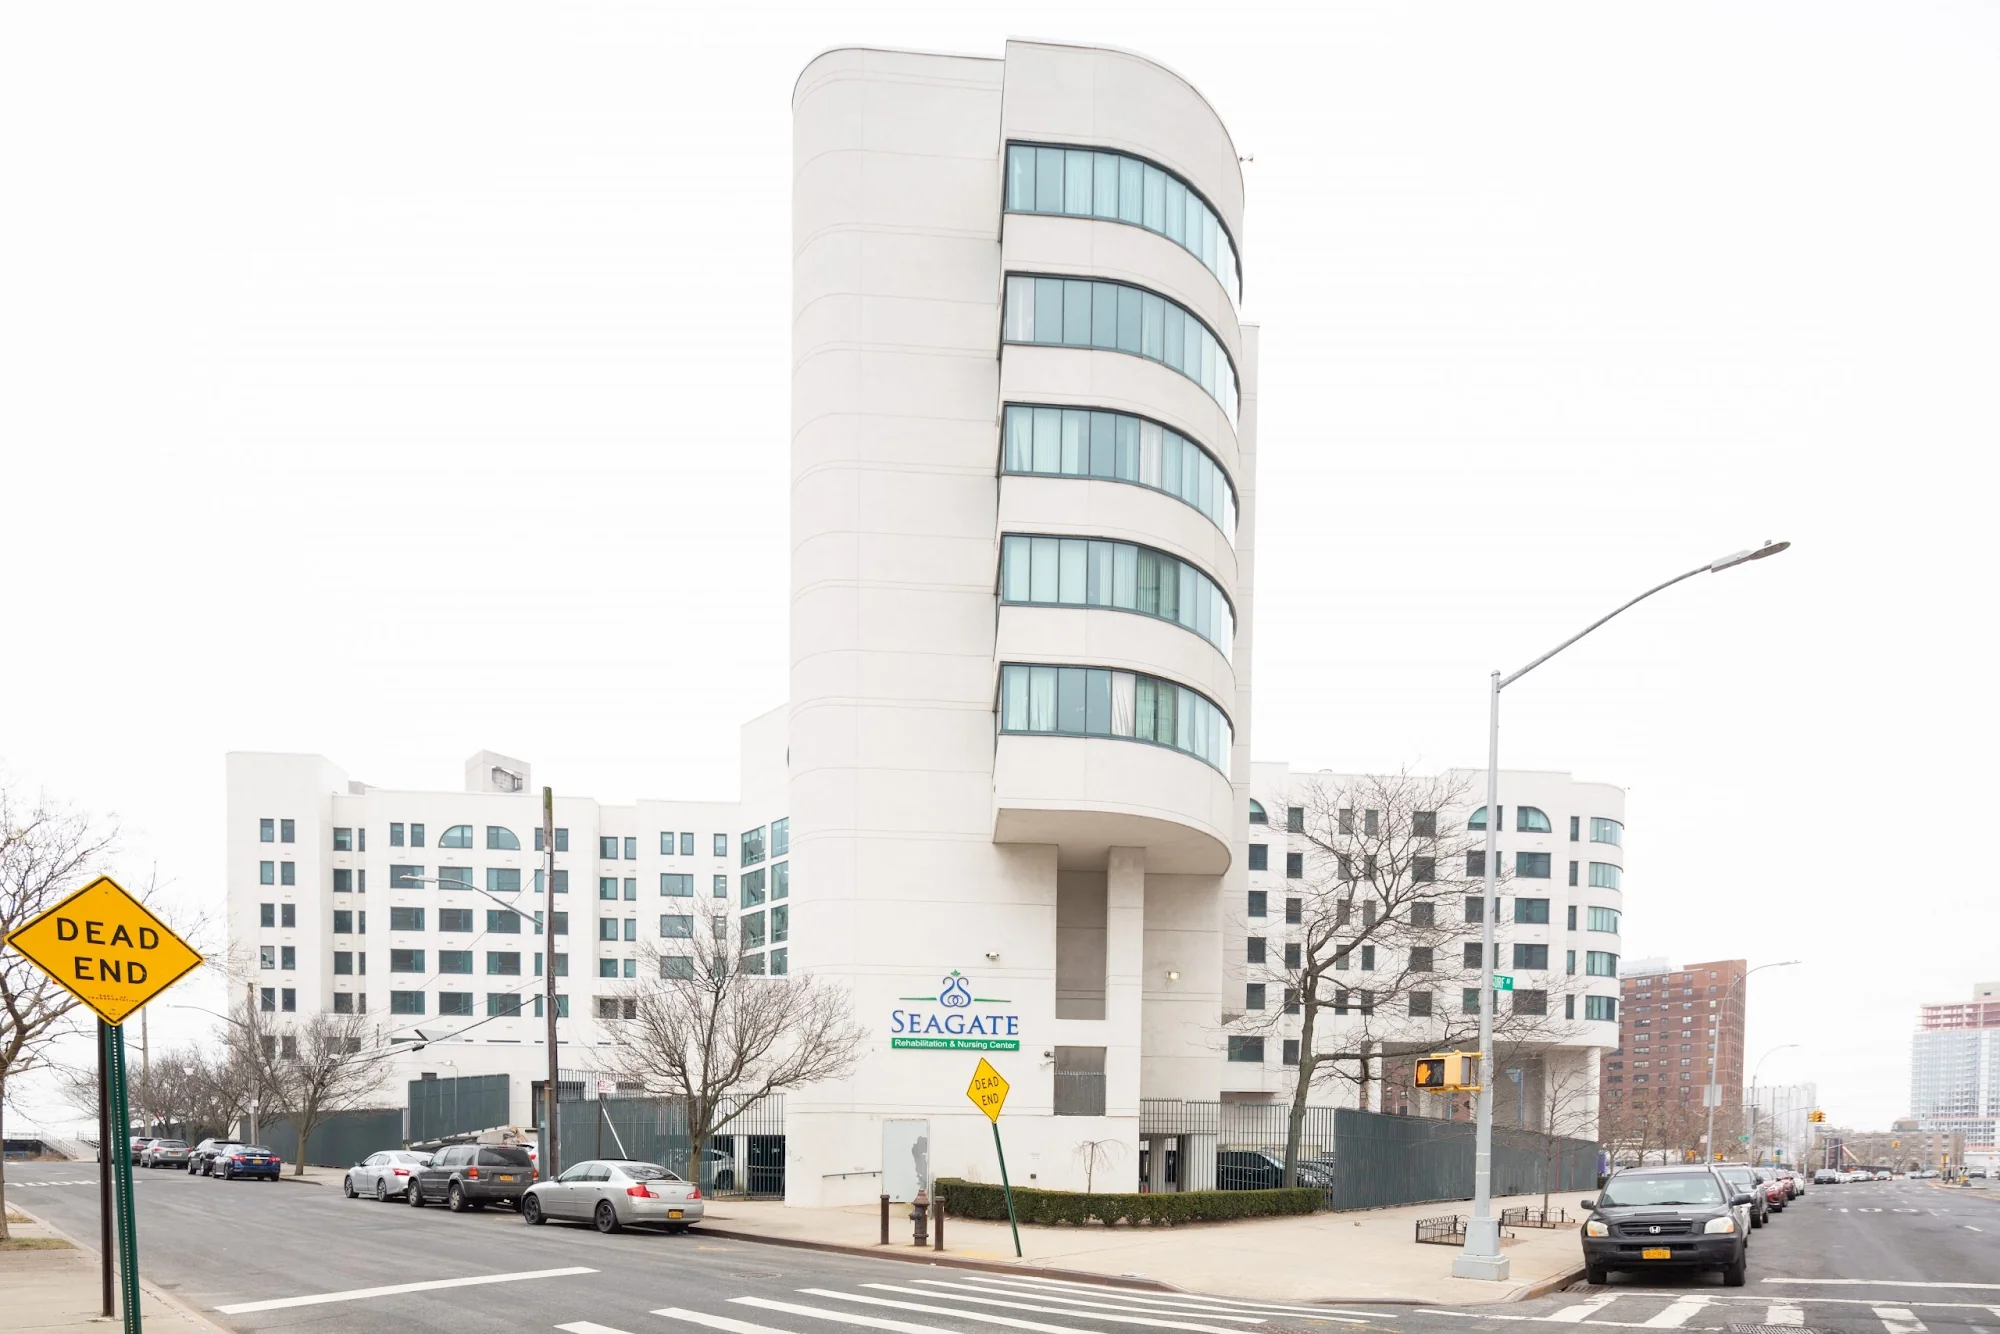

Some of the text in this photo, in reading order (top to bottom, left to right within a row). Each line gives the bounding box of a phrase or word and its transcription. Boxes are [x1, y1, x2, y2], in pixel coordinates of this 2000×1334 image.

[56, 917, 160, 950] DEAD
[74, 956, 148, 985] END
[894, 1039, 1016, 1049] Rehabilitation & Nursing Center
[975, 1076, 999, 1090] DEAD
[981, 1093, 999, 1106] END
